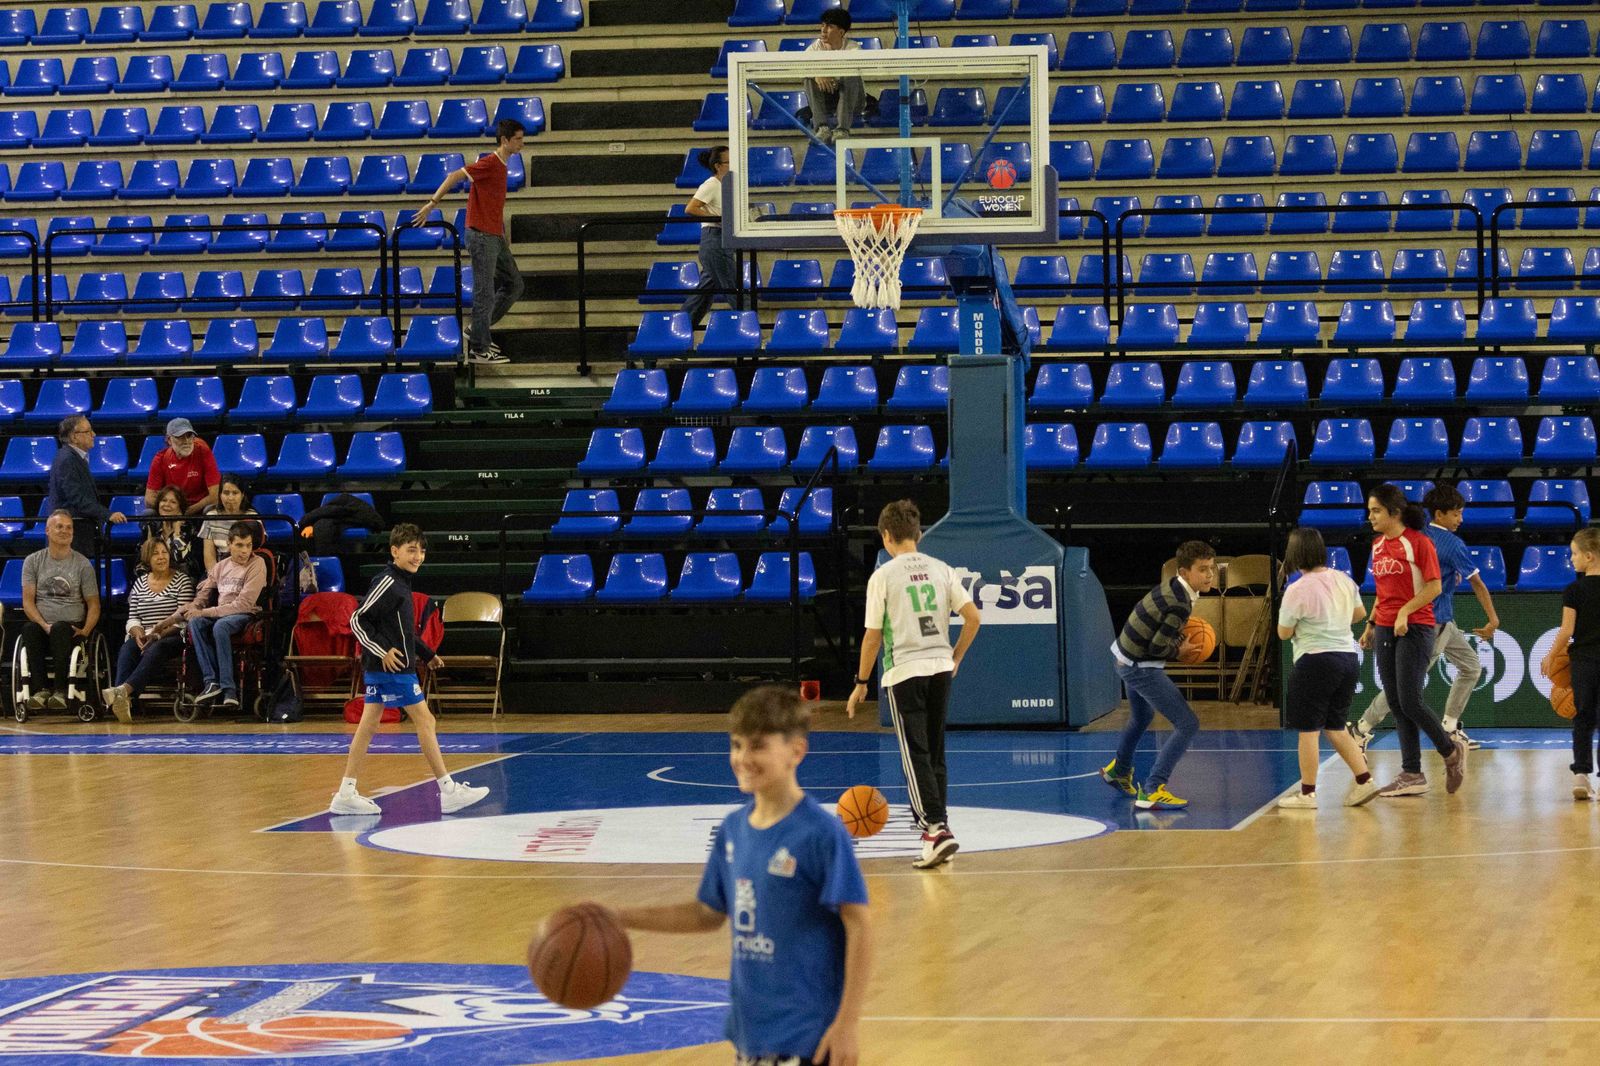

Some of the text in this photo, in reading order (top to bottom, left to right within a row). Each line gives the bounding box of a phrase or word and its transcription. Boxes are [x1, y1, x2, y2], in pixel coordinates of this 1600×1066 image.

[978, 195, 1025, 203] EUROCUP
[982, 203, 1021, 211] WOMEN
[973, 312, 984, 355] MONDO
[906, 583, 937, 612] 12
[1011, 698, 1054, 708] MONDO
